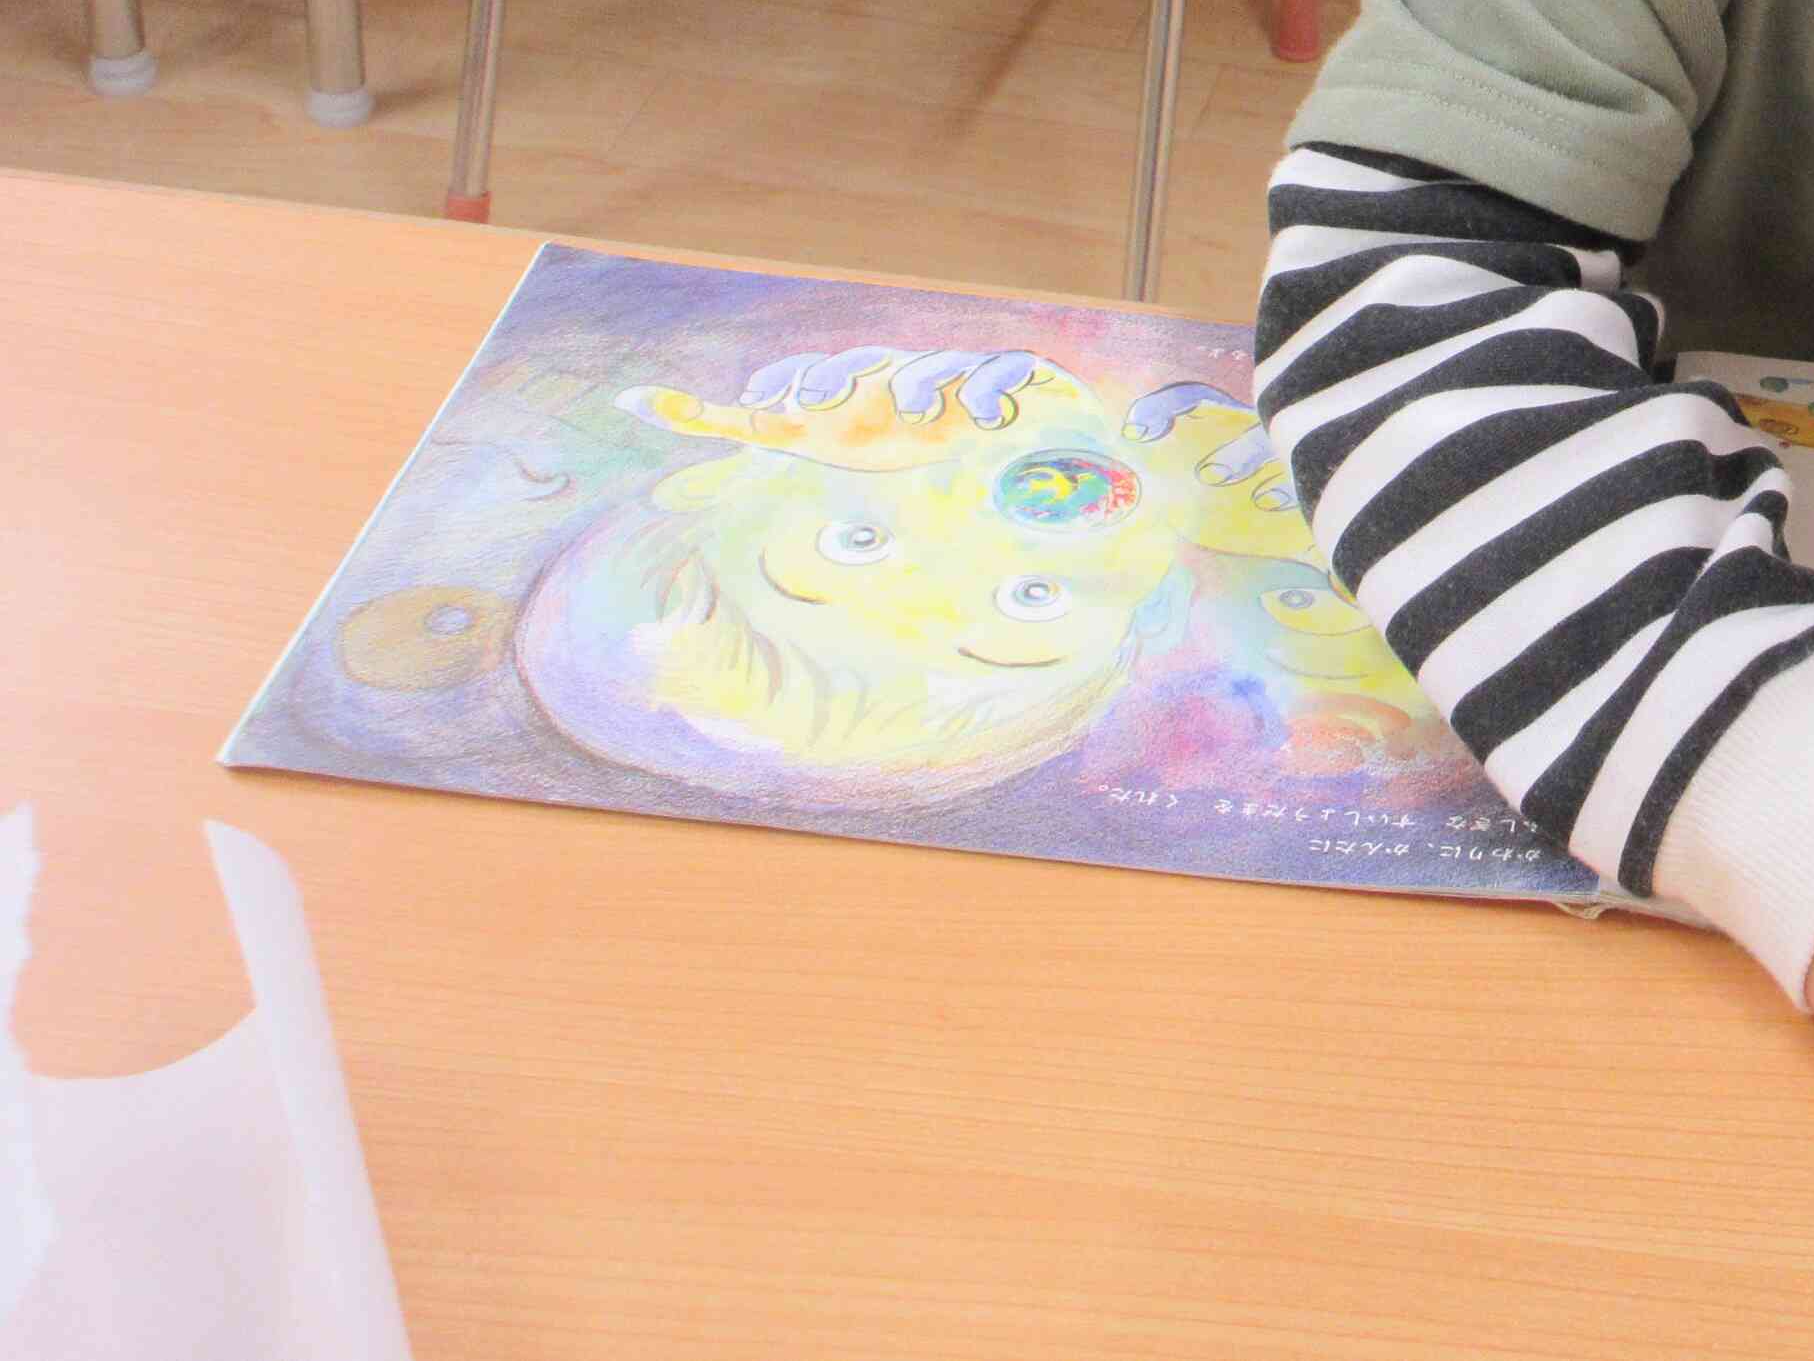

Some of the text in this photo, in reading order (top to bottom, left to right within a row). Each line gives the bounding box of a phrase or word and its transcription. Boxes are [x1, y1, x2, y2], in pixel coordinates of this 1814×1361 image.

[1098, 783, 1178, 808] くれた。
[1214, 797, 1416, 829] すいしょうだまを
